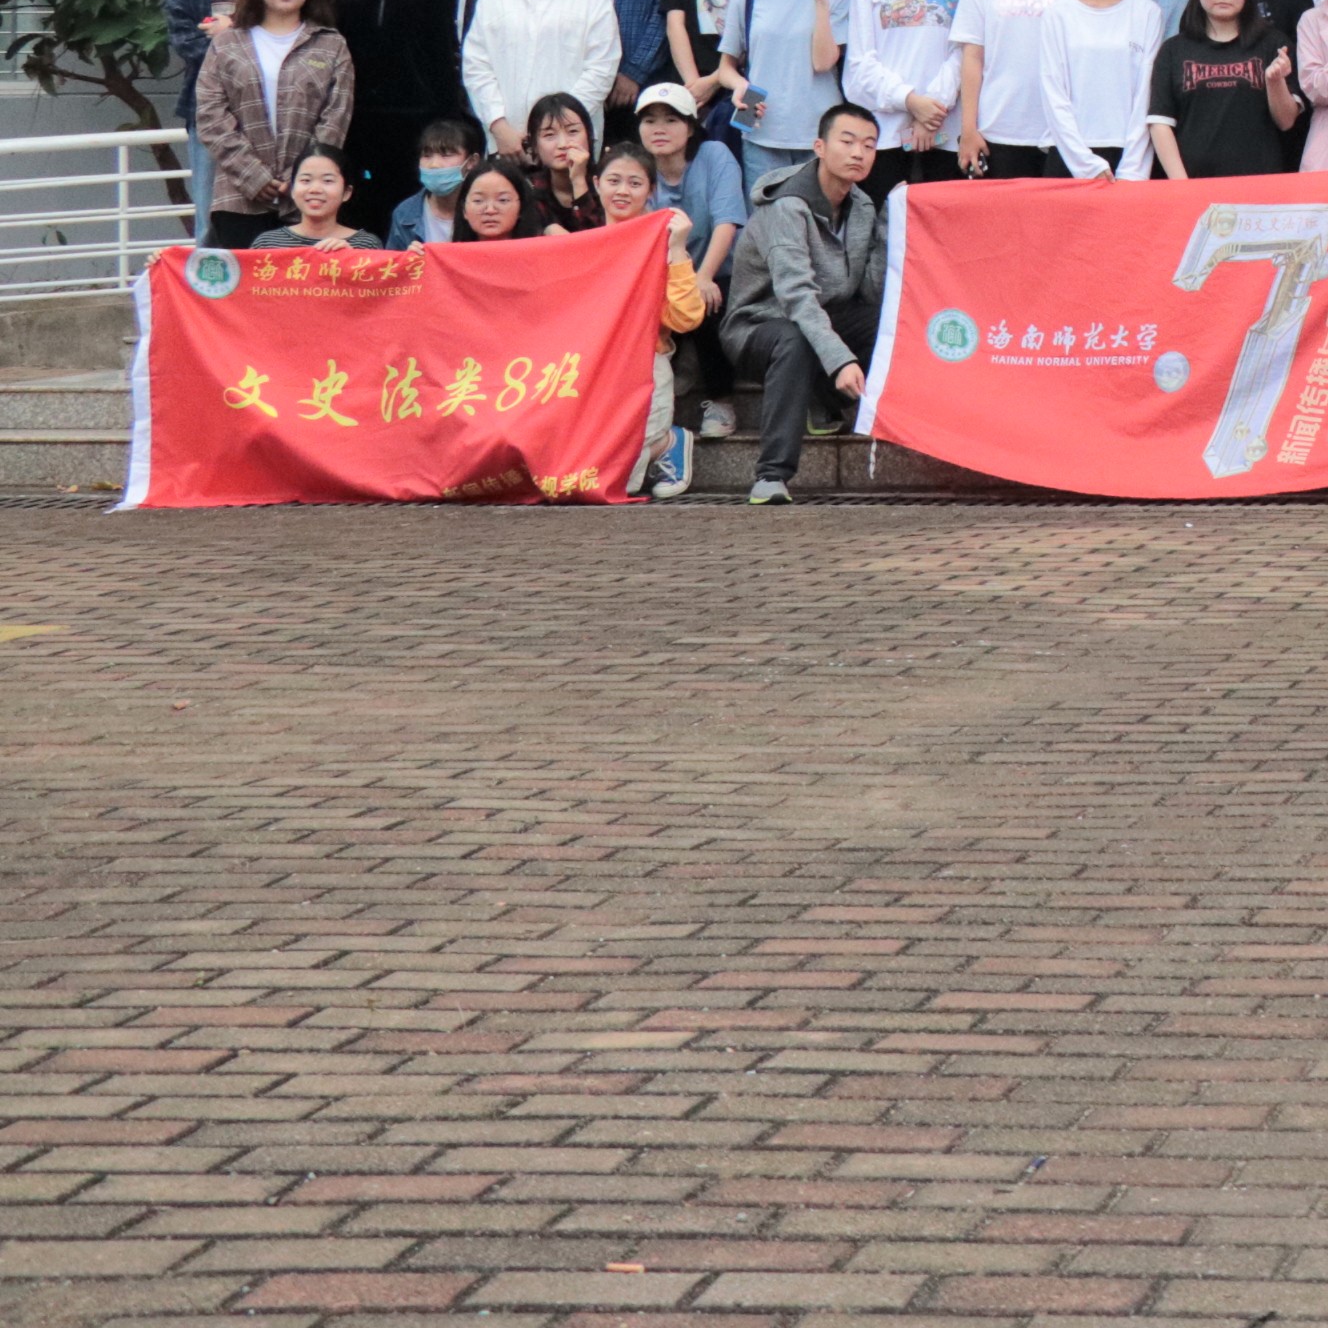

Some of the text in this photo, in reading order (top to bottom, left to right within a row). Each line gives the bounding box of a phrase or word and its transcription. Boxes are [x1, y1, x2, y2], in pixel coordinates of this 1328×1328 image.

[1182, 56, 1265, 92] AMERICAN
[1205, 80, 1238, 89] COWBOY
[252, 253, 426, 285] 海南师范大学
[251, 284, 424, 298] HAINAN NORMAL UNIVERSITY
[986, 318, 1158, 356] 海南师范大学
[990, 354, 1150, 367] HAINAN NORMAL UNIVERSITY
[222, 351, 581, 428] 文史法类8班
